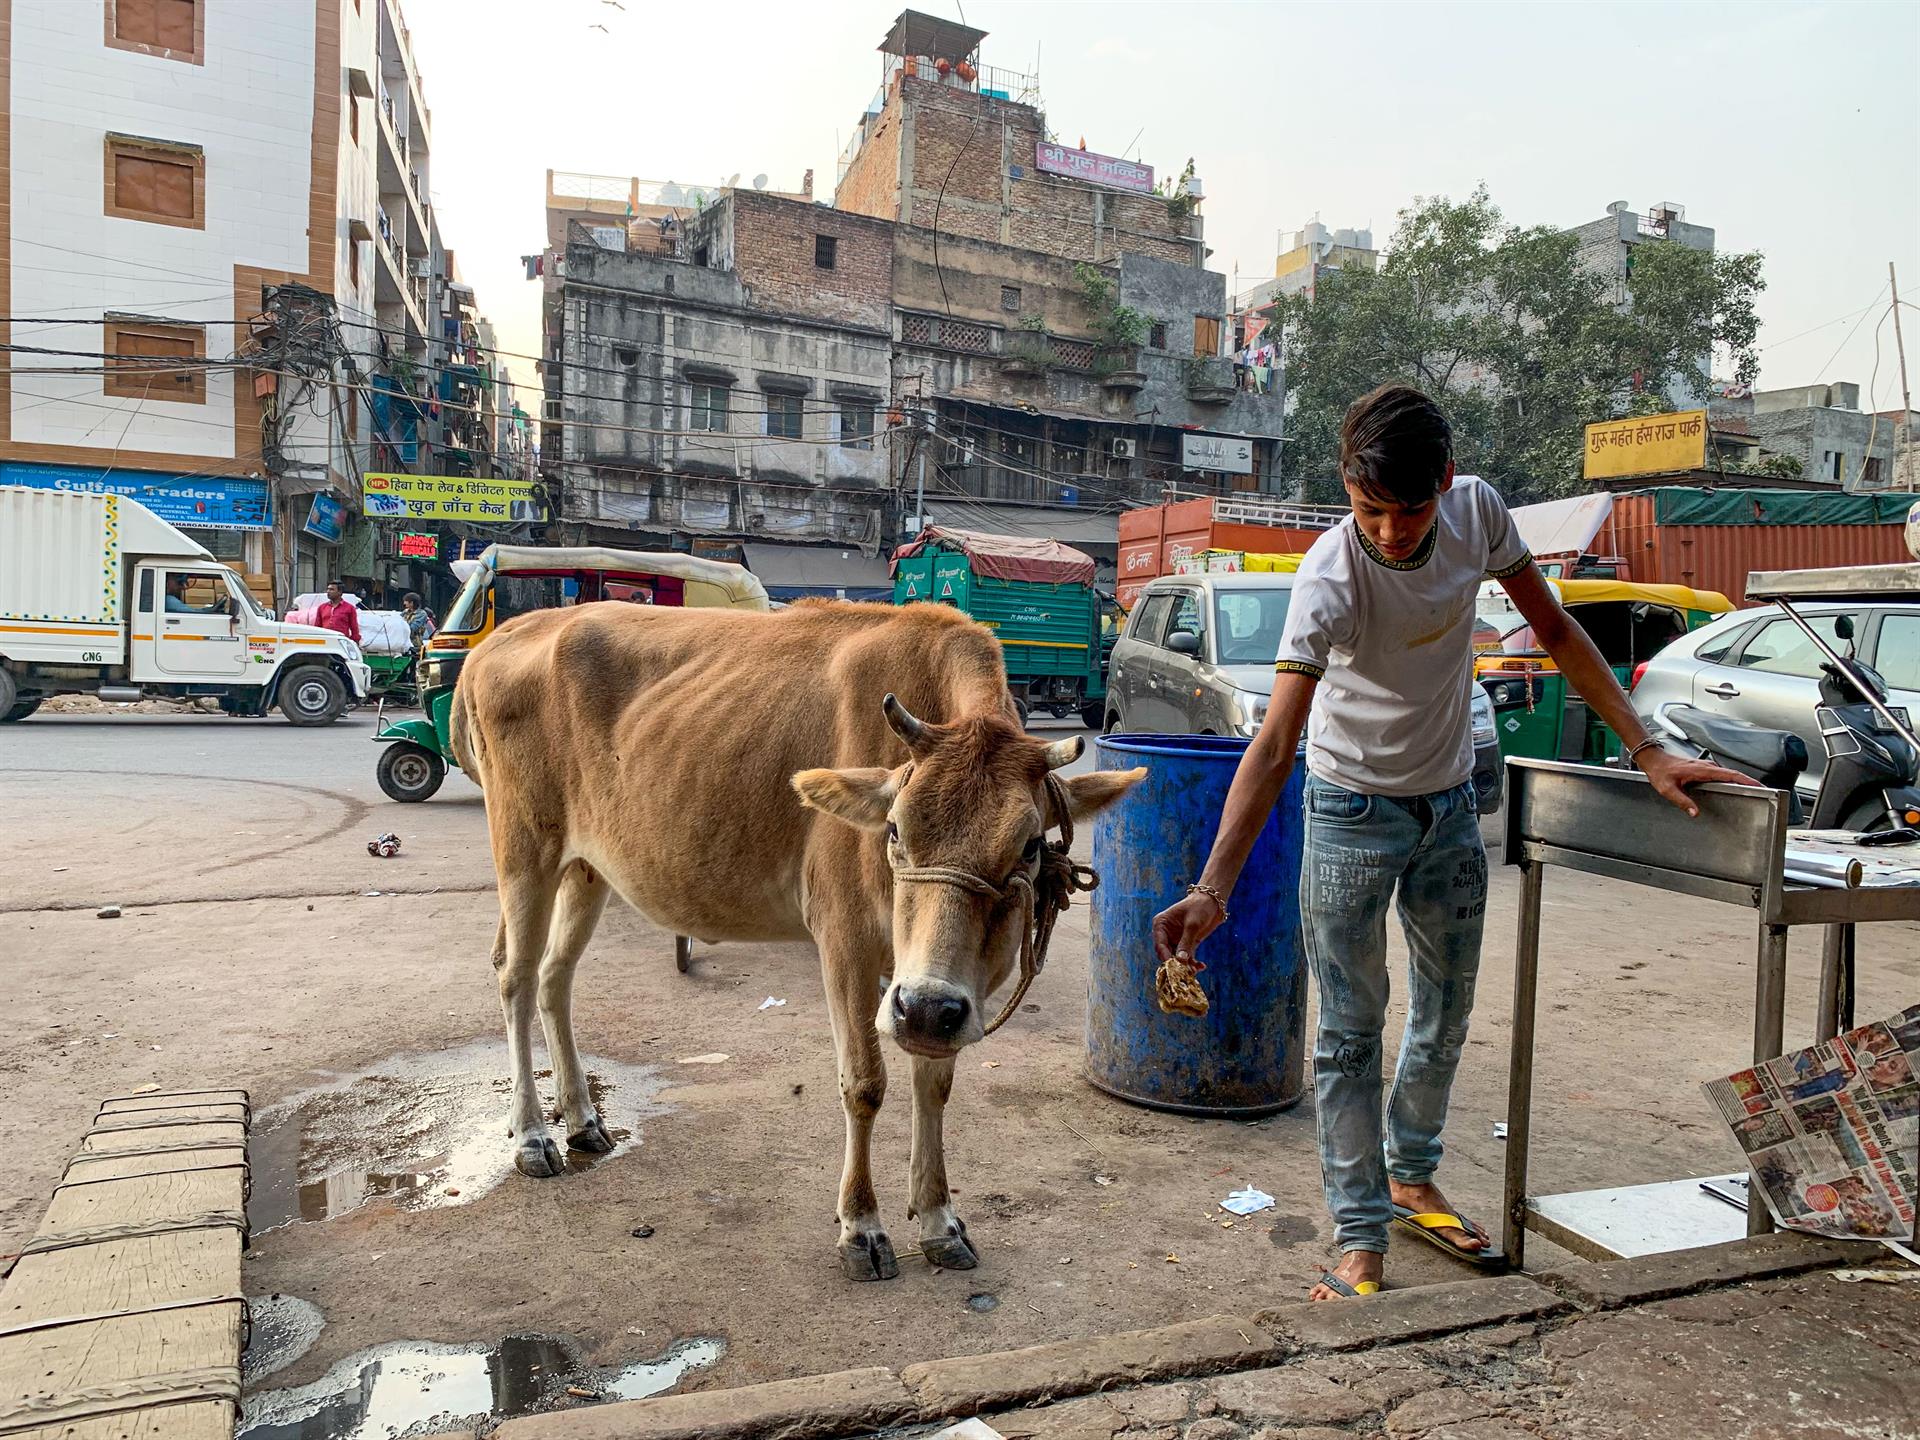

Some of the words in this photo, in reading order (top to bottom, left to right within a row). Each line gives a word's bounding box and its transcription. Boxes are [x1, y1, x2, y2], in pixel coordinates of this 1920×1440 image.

[1045, 148, 1066, 164] श्री
[1610, 426, 1633, 447] महंत
[1636, 423, 1654, 445] हंस
[1655, 423, 1676, 442] राज
[1679, 416, 1702, 438] पार्क
[54, 479, 137, 494] Gulfam
[143, 485, 225, 500] Traders
[371, 480, 388, 488] HPL
[417, 479, 433, 492] पेथ
[457, 485, 464, 493] &
[466, 482, 504, 496] डिजिटल
[408, 500, 435, 516] खून
[442, 496, 473, 513] जाँच
[478, 500, 506, 516] केन्द्र
[82, 652, 102, 662] CNG
